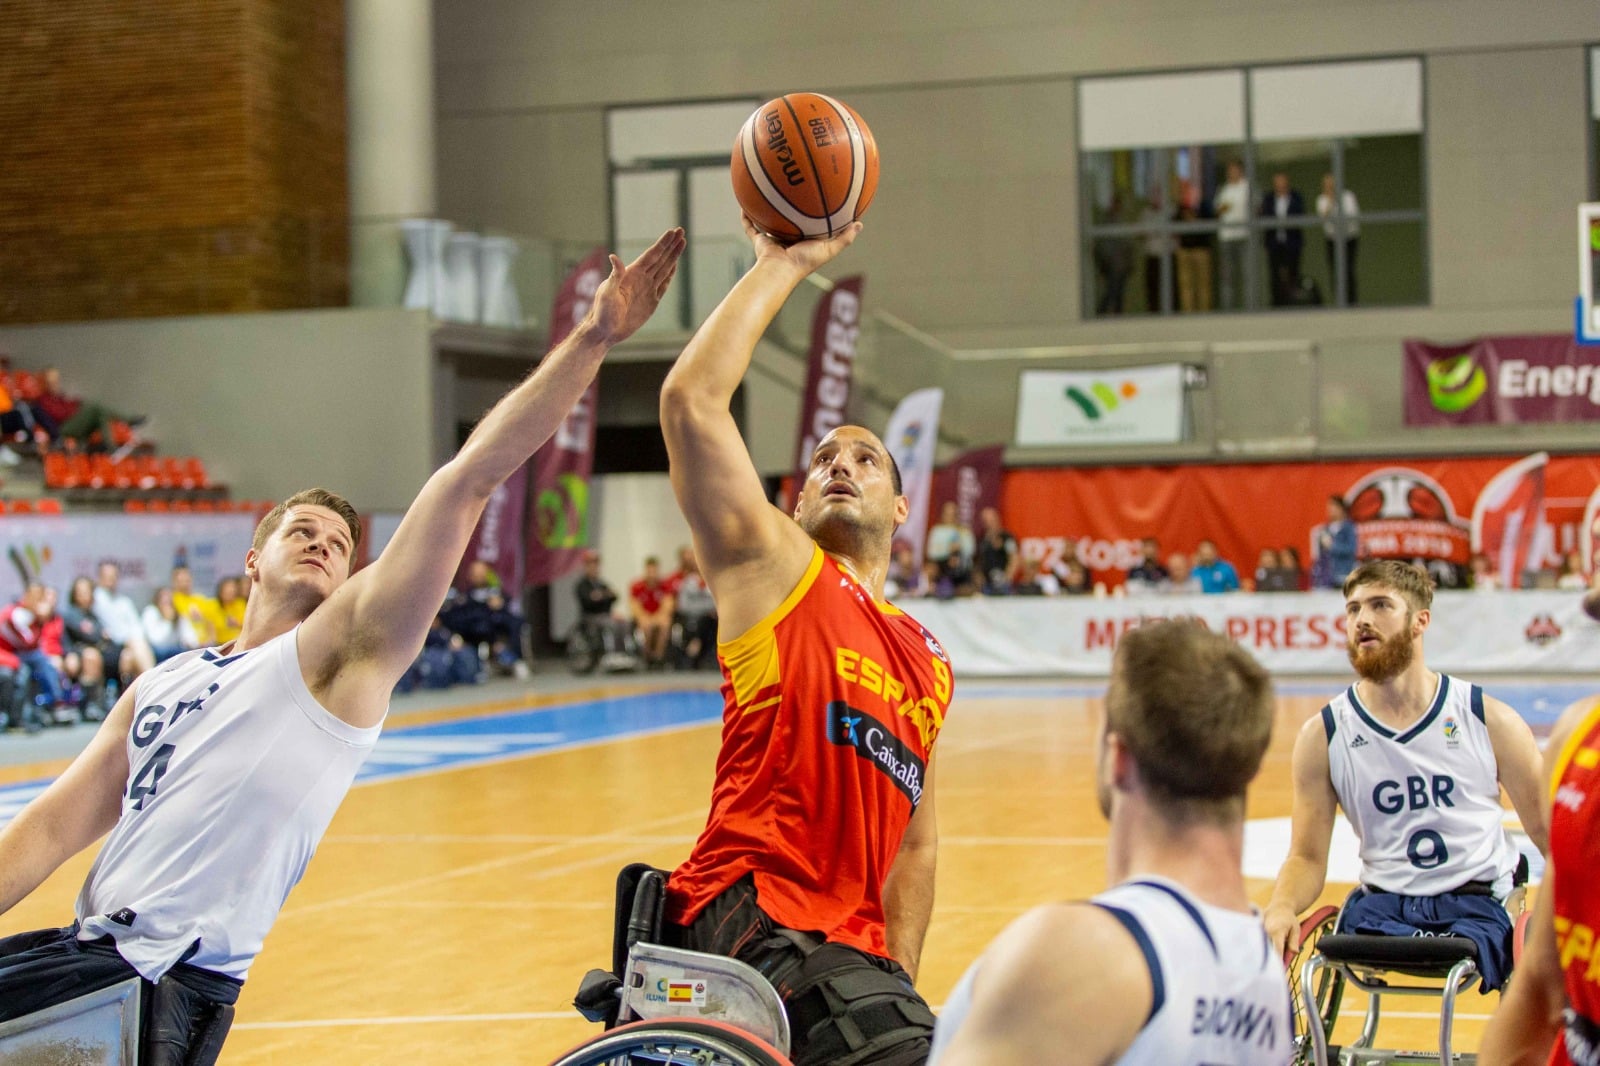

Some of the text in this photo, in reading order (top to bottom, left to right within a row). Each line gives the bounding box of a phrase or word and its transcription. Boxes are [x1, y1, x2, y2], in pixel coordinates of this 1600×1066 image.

[766, 109, 805, 187] molten
[808, 117, 832, 147] FIBA
[129, 743, 176, 810] 4
[1372, 774, 1456, 815] GBR
[1406, 829, 1449, 869] 9
